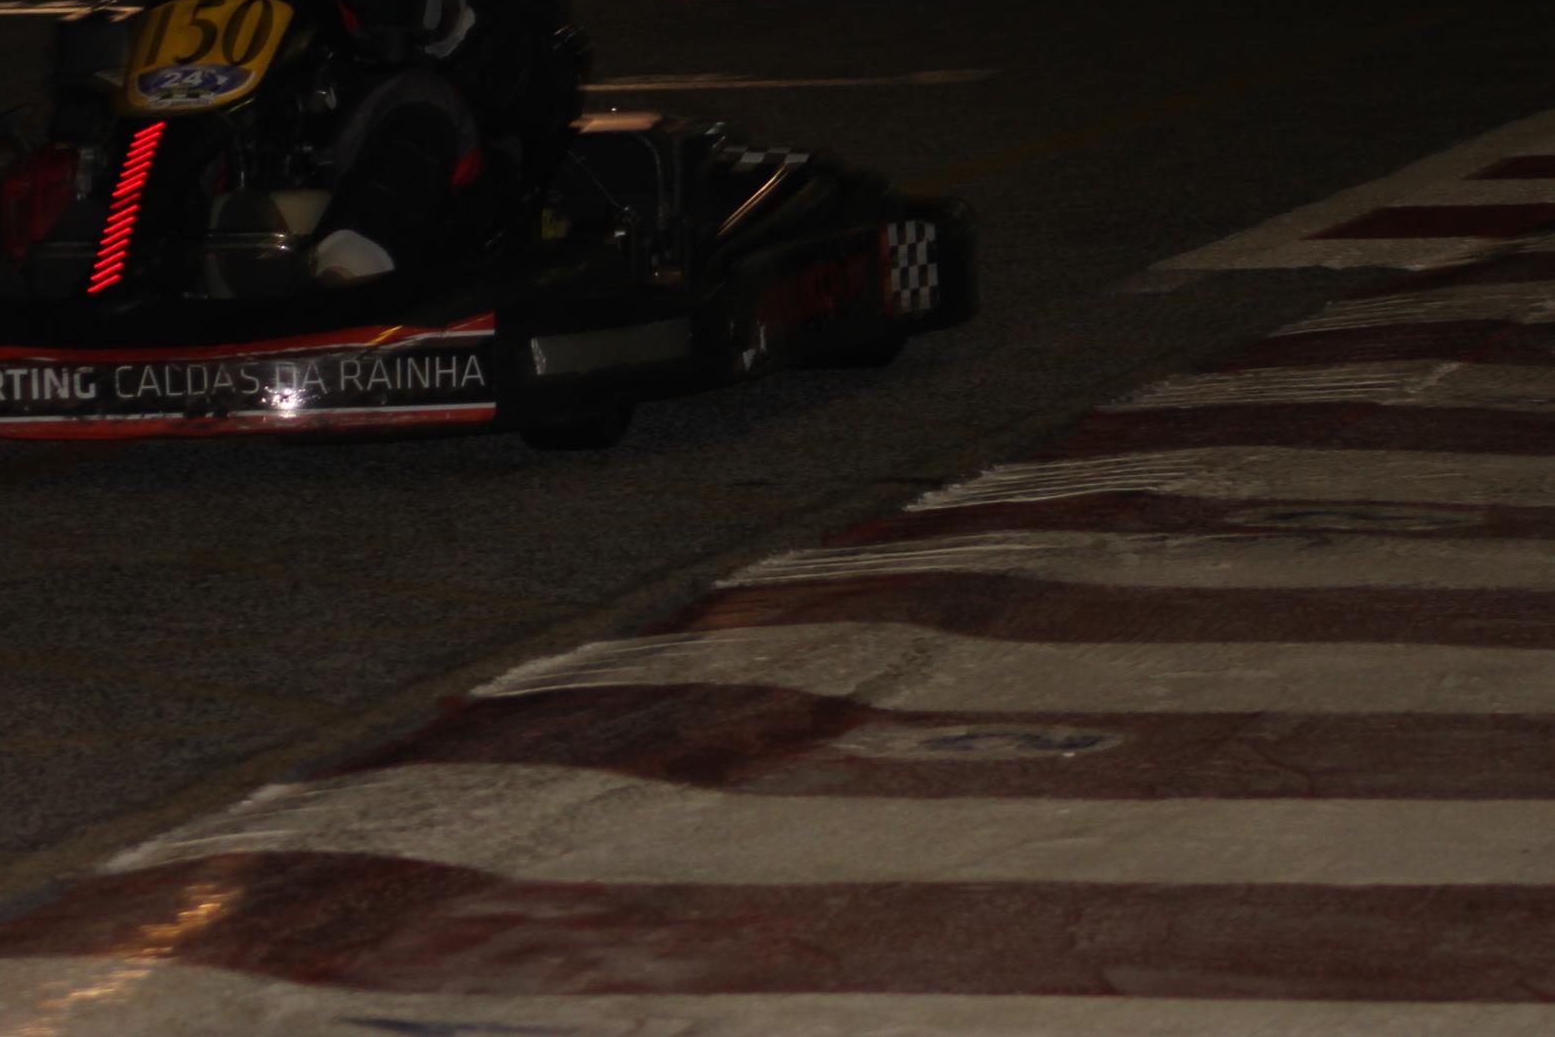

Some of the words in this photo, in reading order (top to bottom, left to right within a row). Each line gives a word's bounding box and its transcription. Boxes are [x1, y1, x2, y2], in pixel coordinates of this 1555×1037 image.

[115, 361, 261, 398] CALDAS
[275, 360, 328, 395] DA
[340, 354, 486, 392] RAINHA
